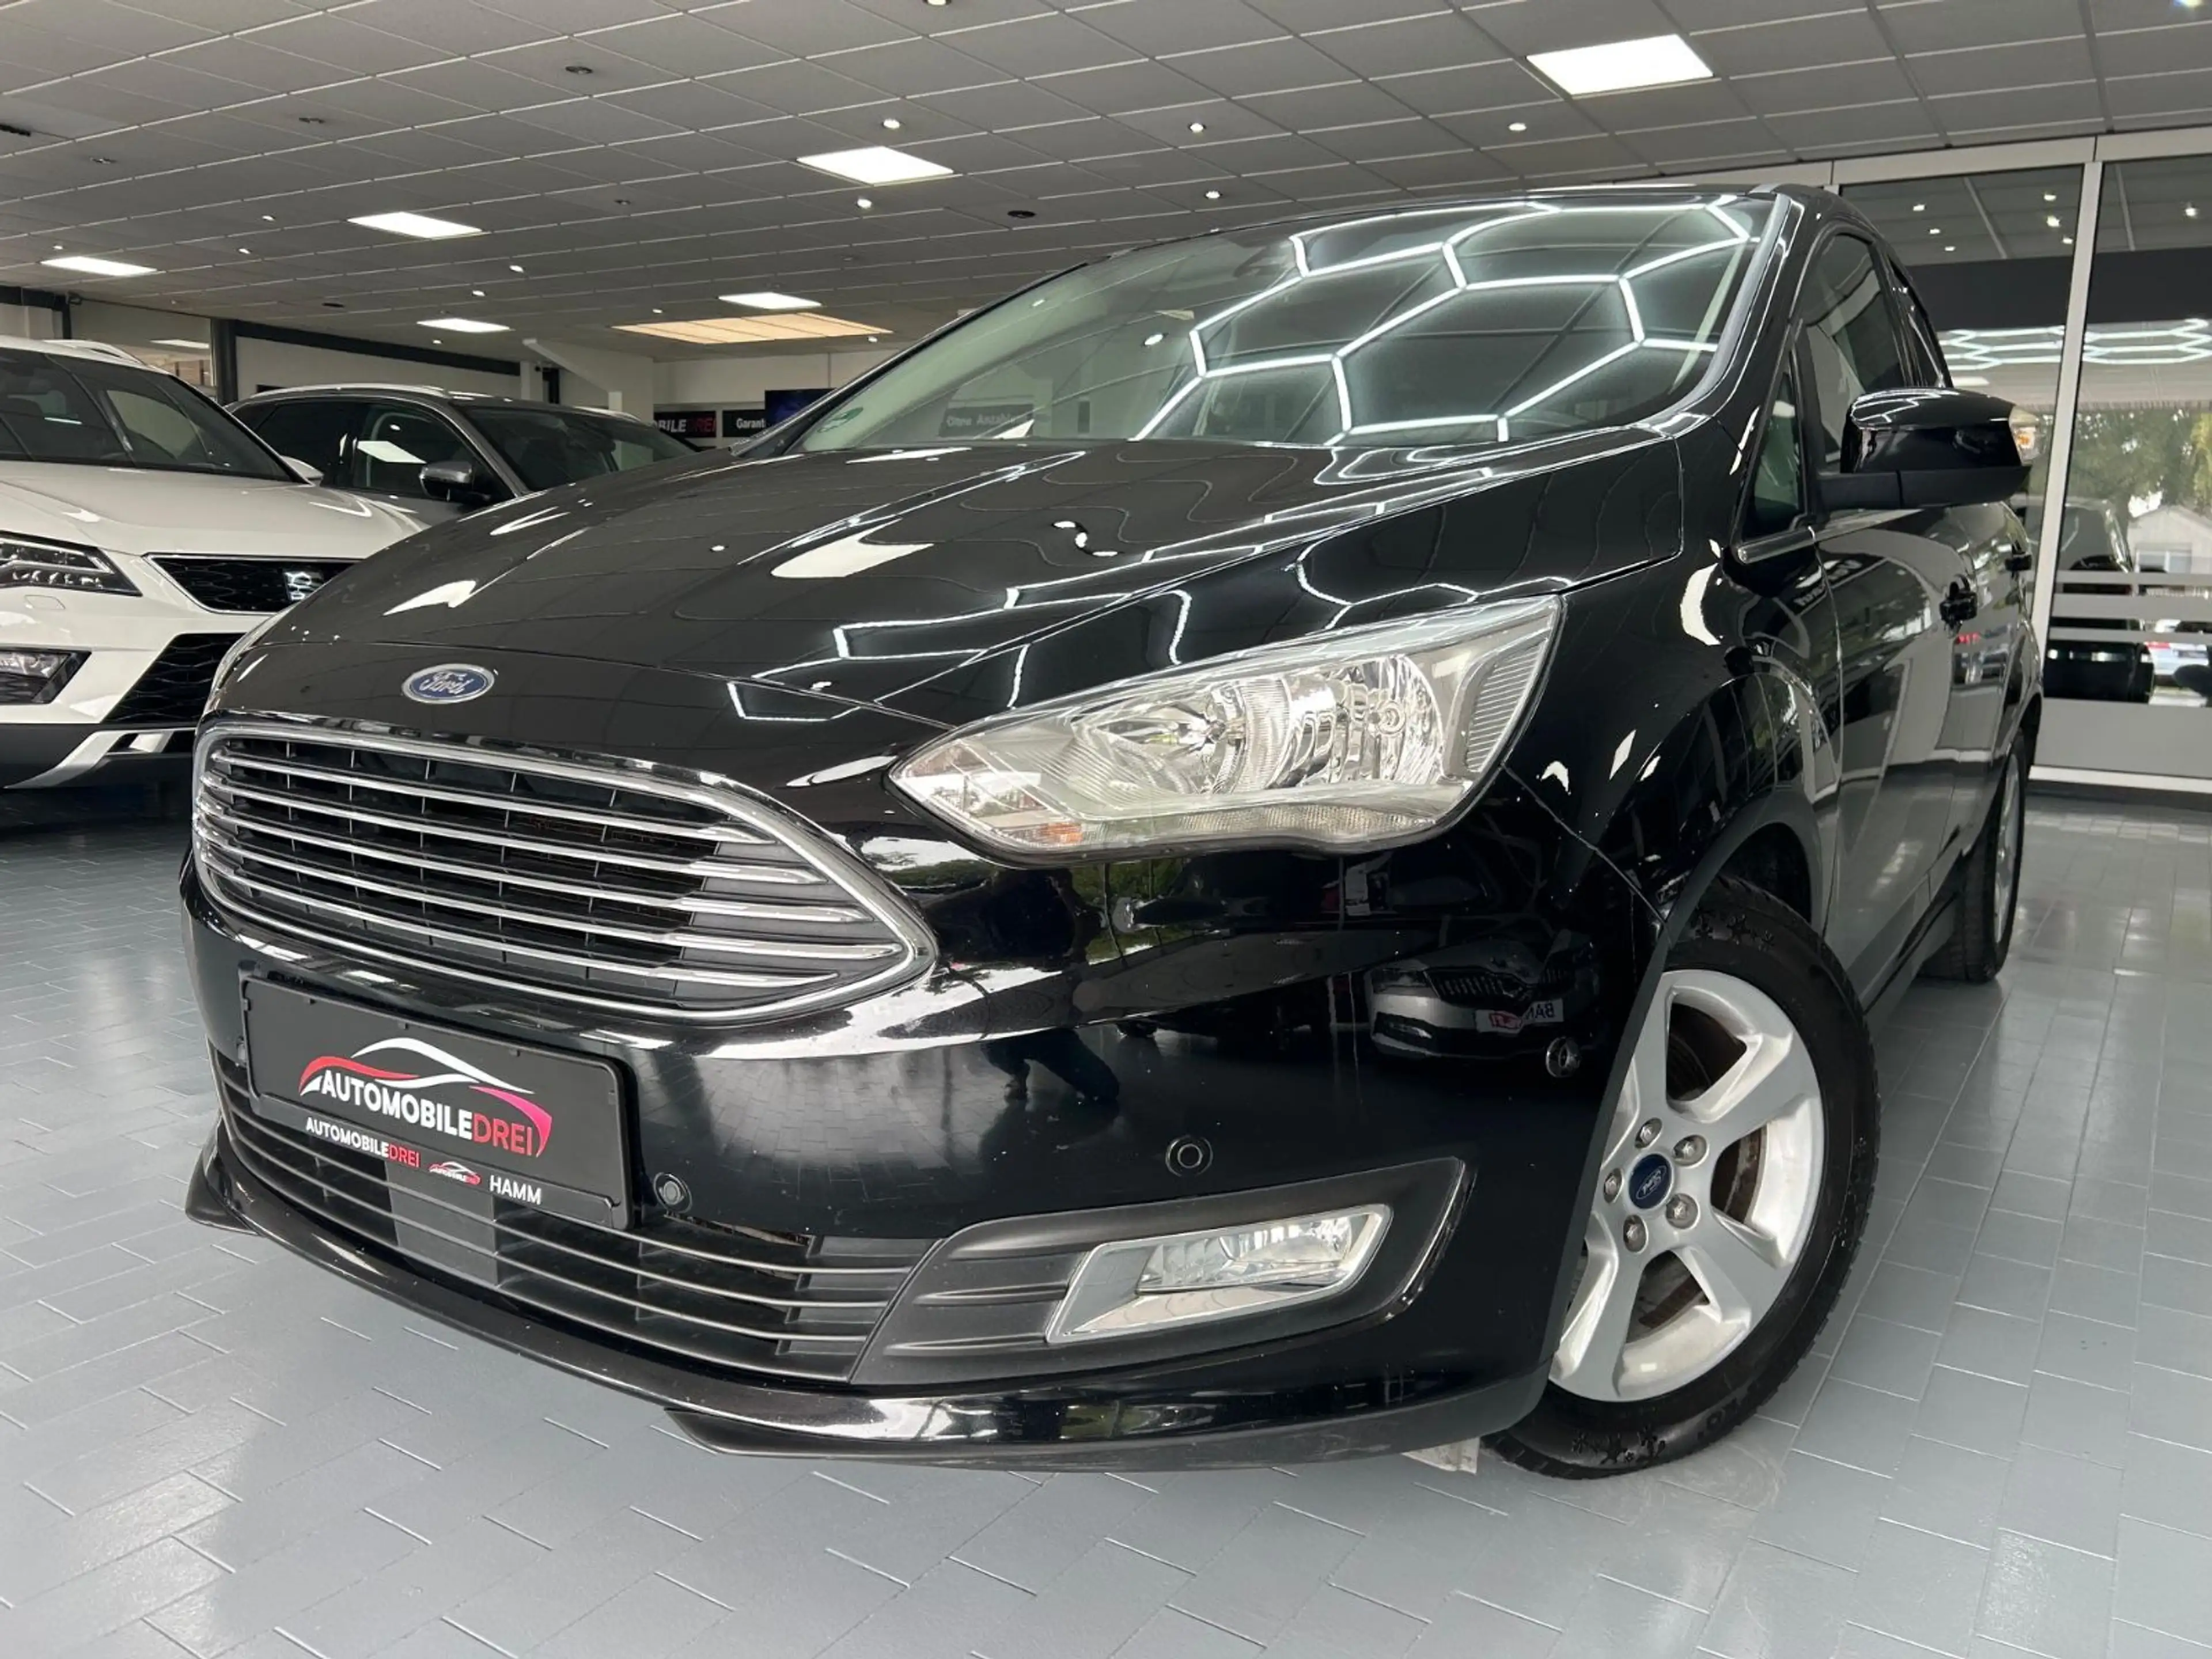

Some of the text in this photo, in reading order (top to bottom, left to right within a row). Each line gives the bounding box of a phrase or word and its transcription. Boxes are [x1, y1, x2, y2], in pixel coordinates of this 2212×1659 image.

[419, 671, 474, 695] Ford
[321, 1069, 533, 1156] AUTOMOBILEDREI
[306, 1117, 420, 1168] AUTOMOBILEDREI
[489, 1175, 541, 1205] HAMM
